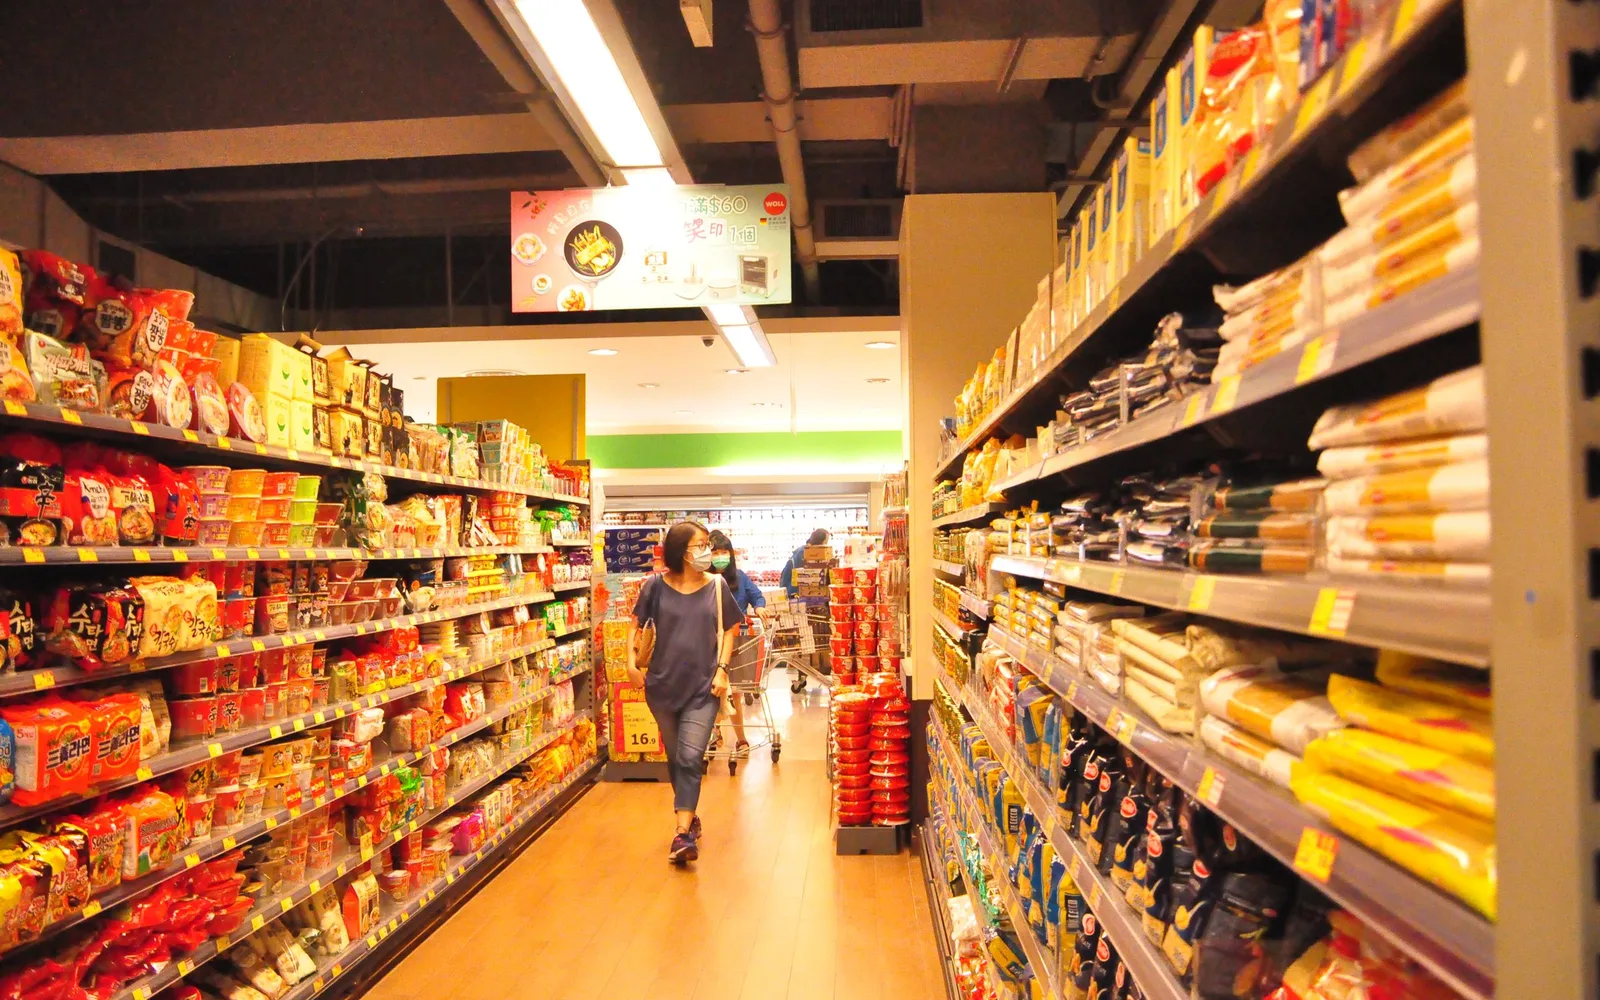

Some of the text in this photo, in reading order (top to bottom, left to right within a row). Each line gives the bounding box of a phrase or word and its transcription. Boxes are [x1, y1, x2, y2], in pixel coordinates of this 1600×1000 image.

[765, 200, 785, 208] WOLL
[9, 600, 35, 650] 수타면
[68, 603, 104, 652] 수타면
[631, 733, 656, 745] 16.9
